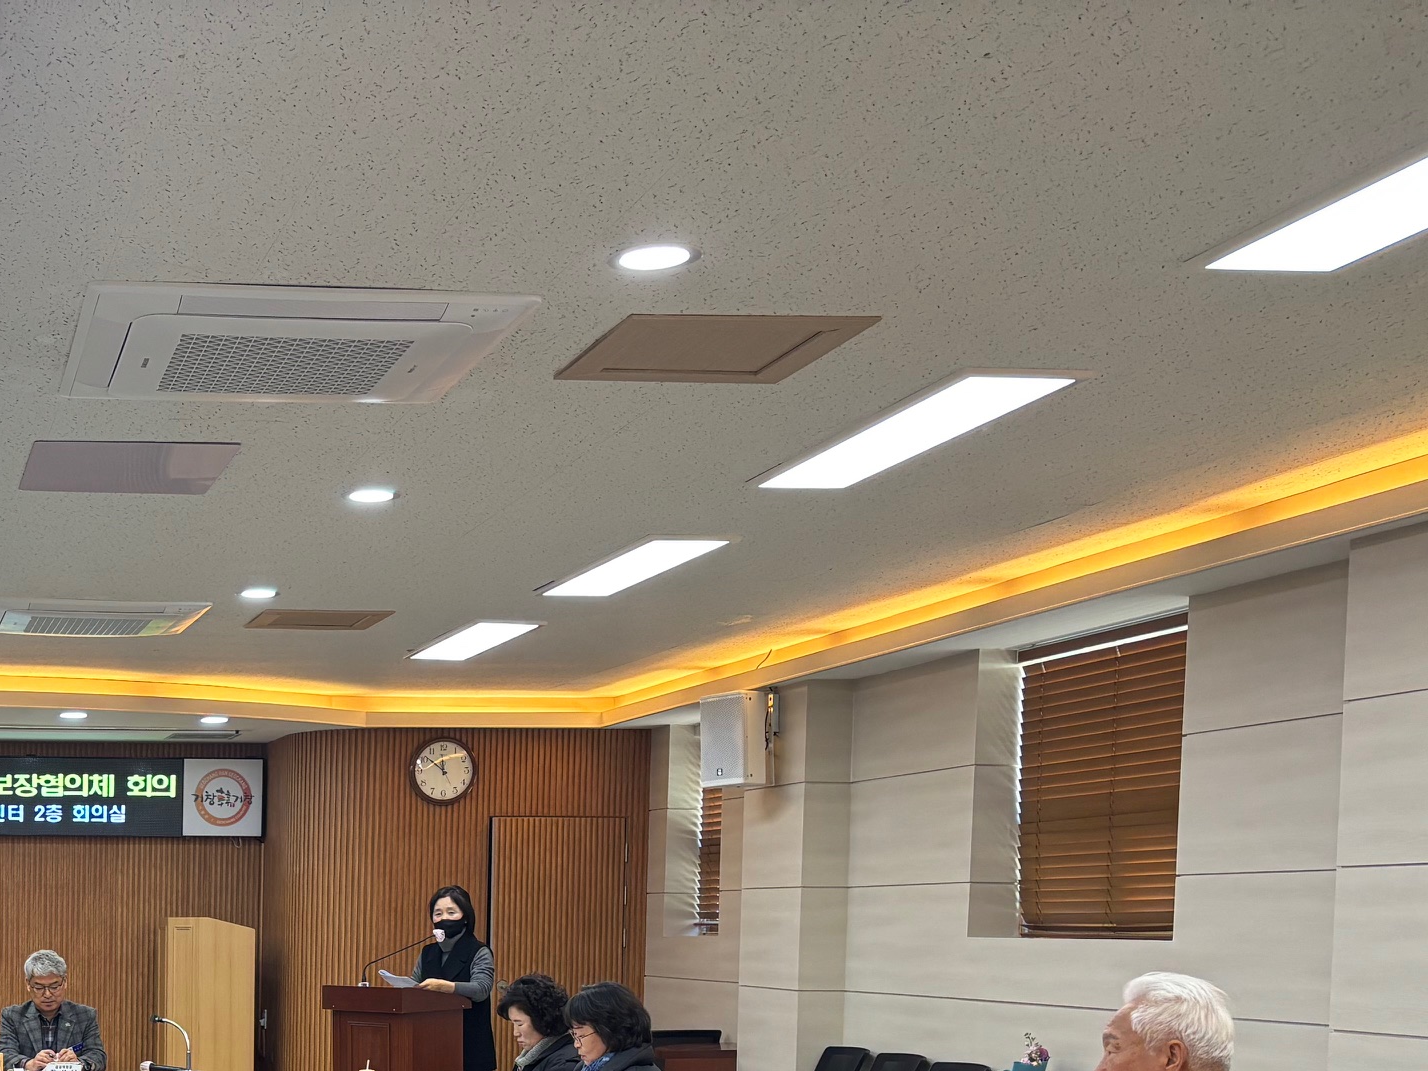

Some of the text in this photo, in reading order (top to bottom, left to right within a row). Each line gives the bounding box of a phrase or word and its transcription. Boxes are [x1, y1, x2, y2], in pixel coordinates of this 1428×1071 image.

[126, 773, 177, 798] 회의
[33, 804, 63, 824] 2층
[72, 804, 126, 824] 회의실
